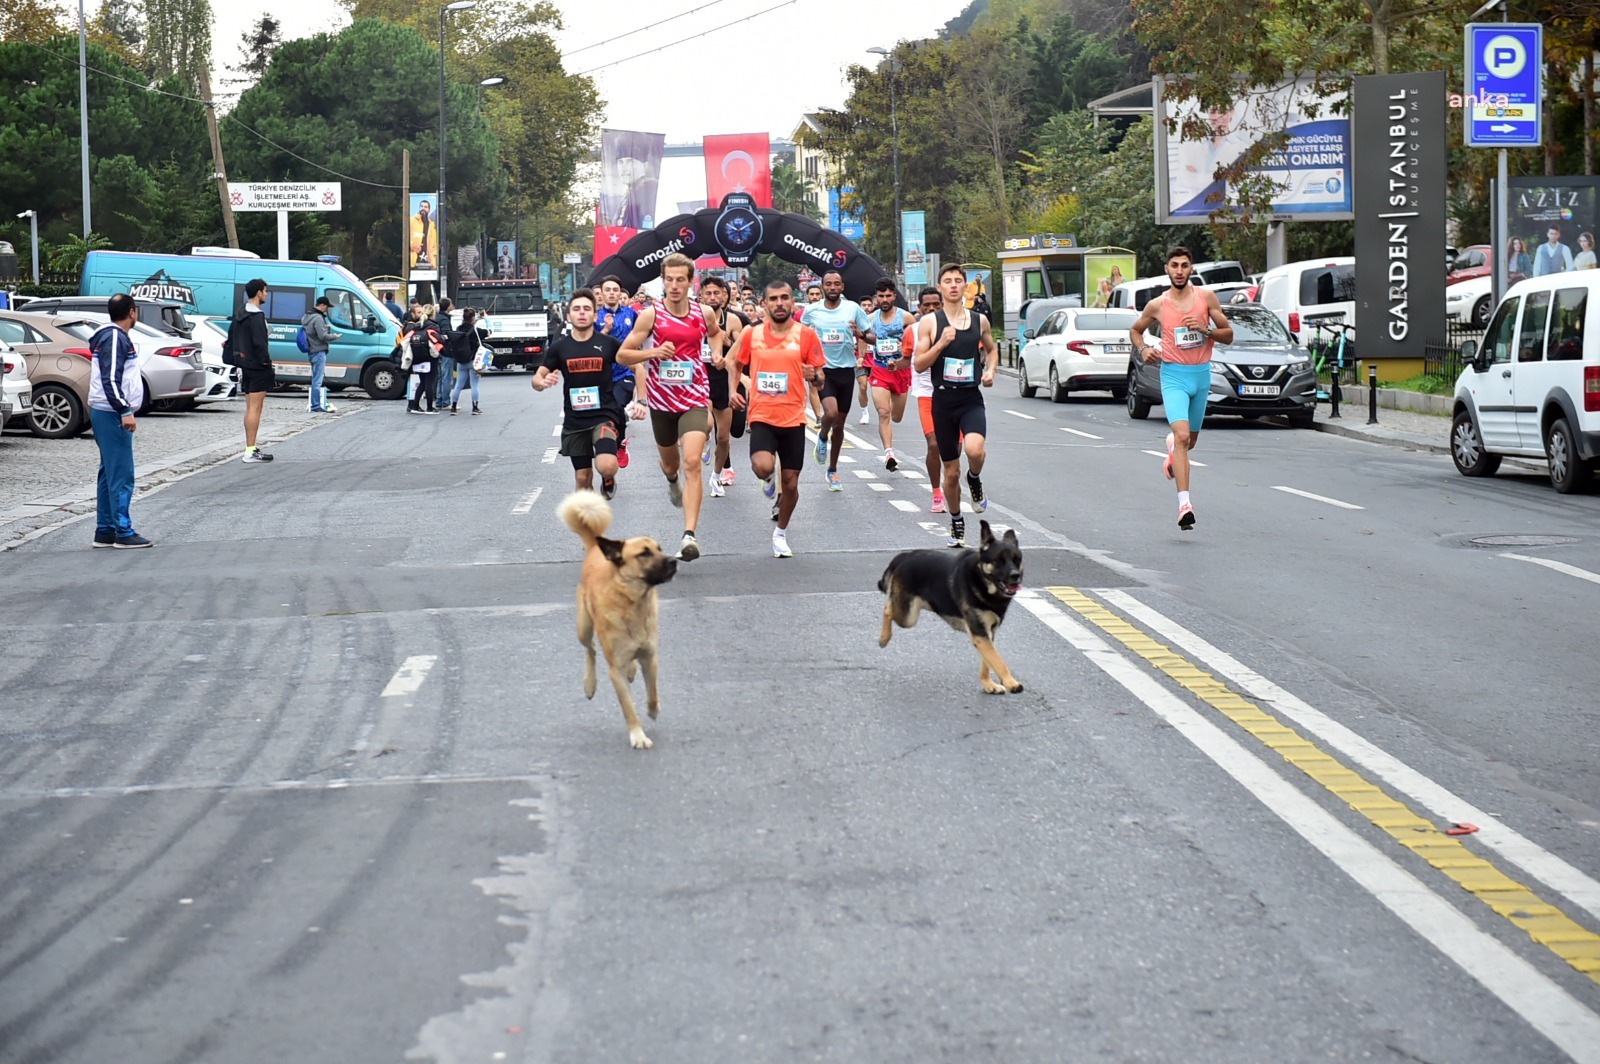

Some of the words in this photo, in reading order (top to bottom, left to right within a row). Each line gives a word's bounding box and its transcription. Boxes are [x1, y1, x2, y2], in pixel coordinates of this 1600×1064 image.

[1494, 48, 1516, 68] P
[1306, 134, 1344, 143] GÜCÜYLE
[1320, 144, 1343, 154] KARŞI
[1410, 88, 1420, 207] KURUÇEŞME
[1291, 152, 1344, 165] ONARIM
[635, 239, 684, 269] amazfit
[784, 234, 833, 264] amazfit
[1388, 222, 1408, 341] GARDEN
[129, 283, 193, 303] MOBİVET
[1182, 333, 1199, 341] 481
[956, 367, 963, 375] 6
[762, 380, 781, 389] 346
[577, 395, 591, 403] 571
